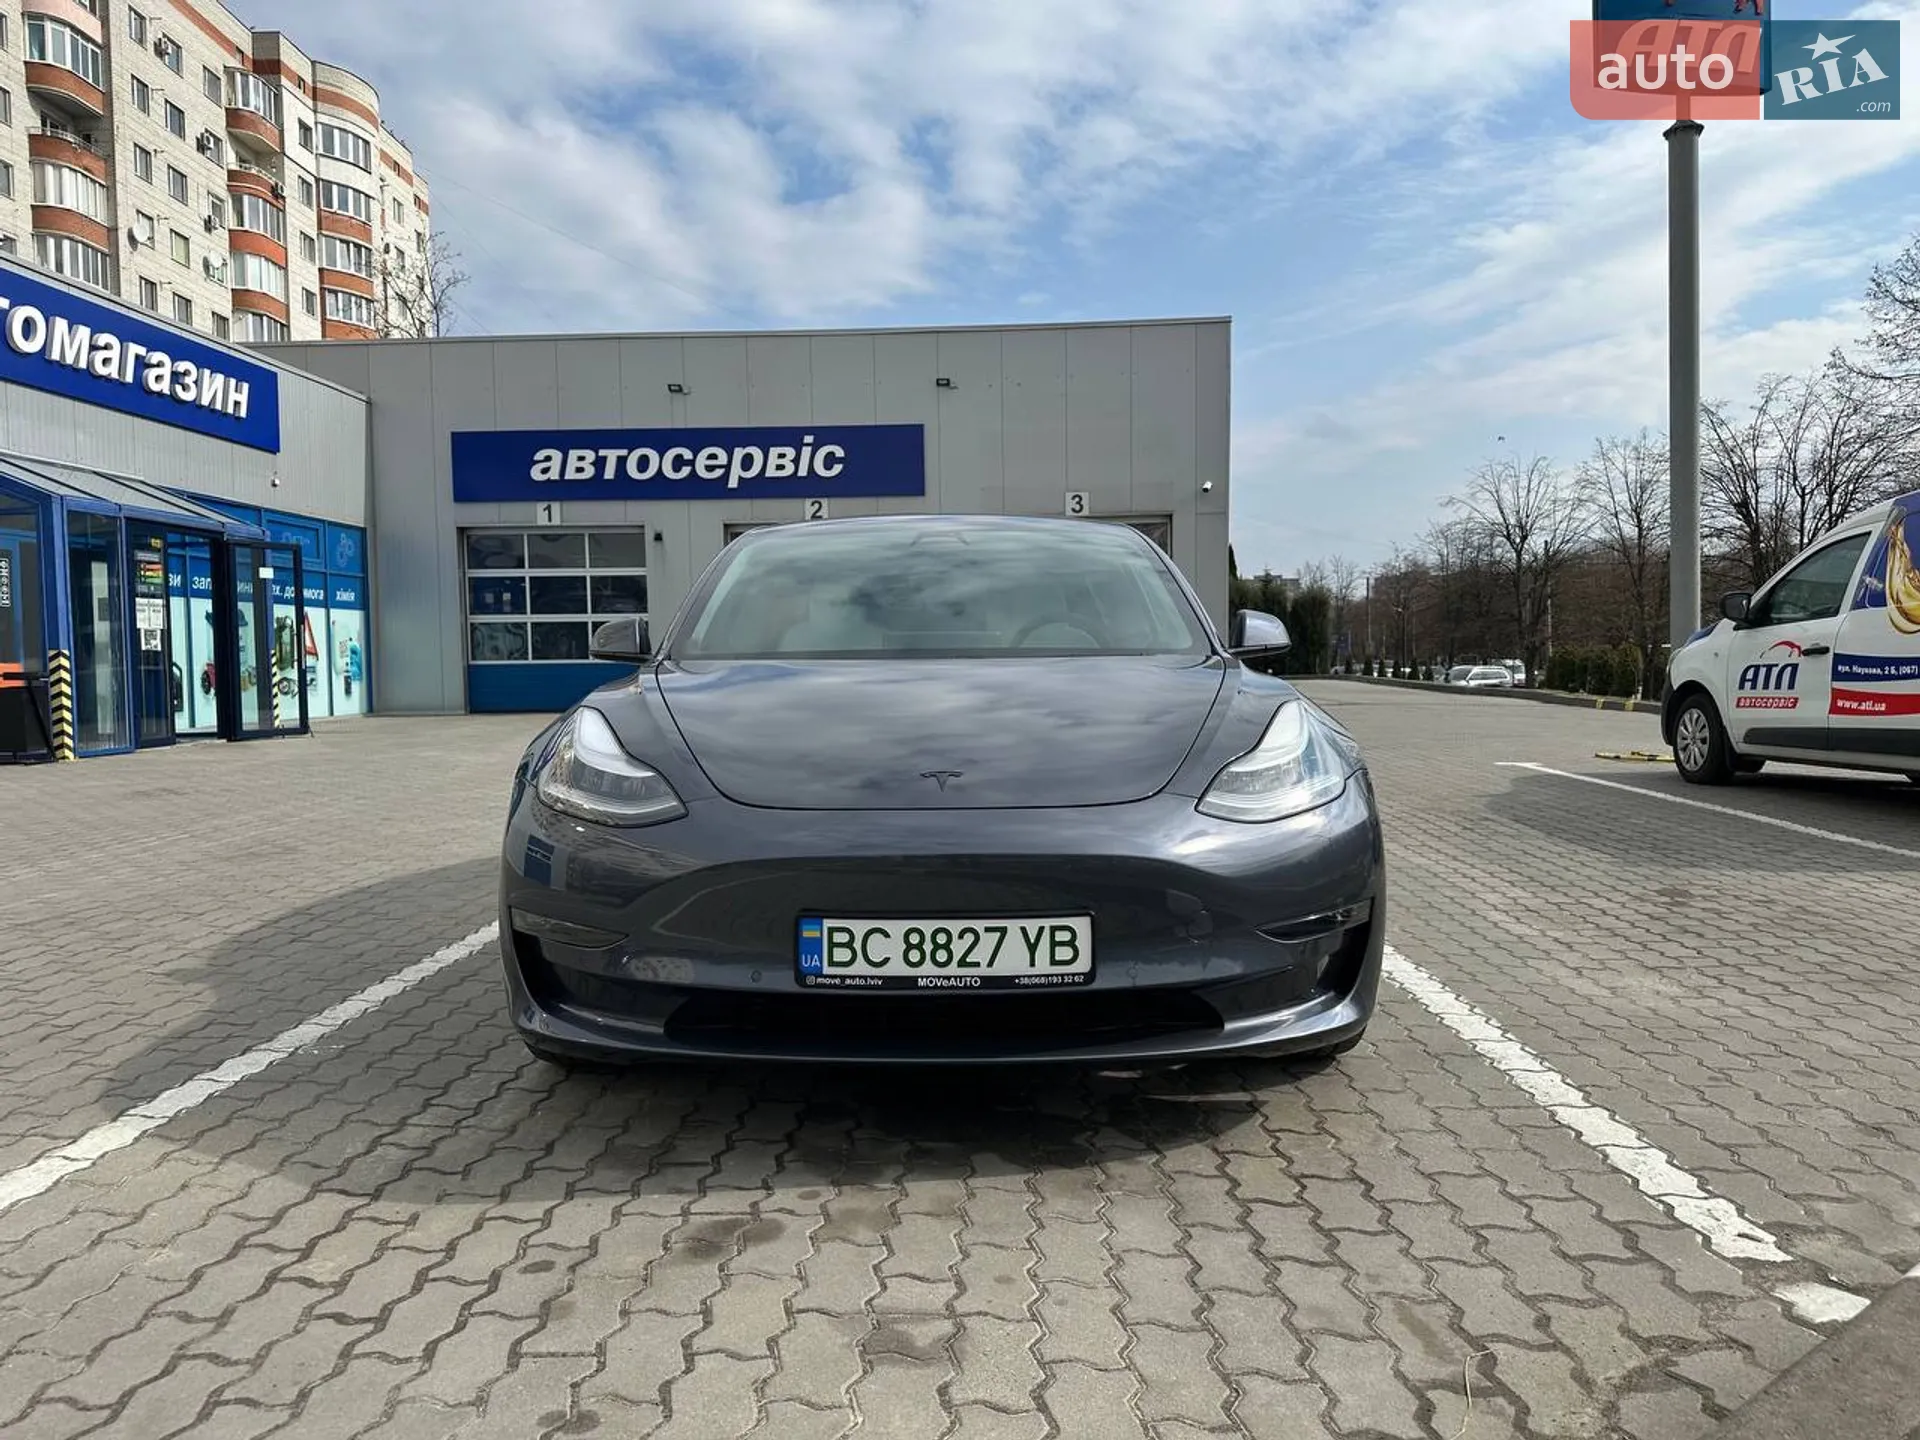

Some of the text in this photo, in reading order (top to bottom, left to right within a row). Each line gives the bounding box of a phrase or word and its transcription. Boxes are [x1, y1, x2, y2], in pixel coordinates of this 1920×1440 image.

[530, 435, 845, 488] автосервіс
[810, 501, 823, 519] 2
[1071, 494, 1084, 513] 3
[543, 504, 553, 523] 1
[1739, 663, 1799, 690] АТЛ
[1884, 666, 1890, 675] 2
[1738, 697, 1796, 709] автосервіс
[1837, 698, 1886, 711] www.atl.ua
[826, 925, 1080, 968] BC 8827 YB
[802, 954, 821, 967] UA
[816, 976, 884, 986] move_auto.lviv
[918, 977, 981, 987] MOVeAUTO
